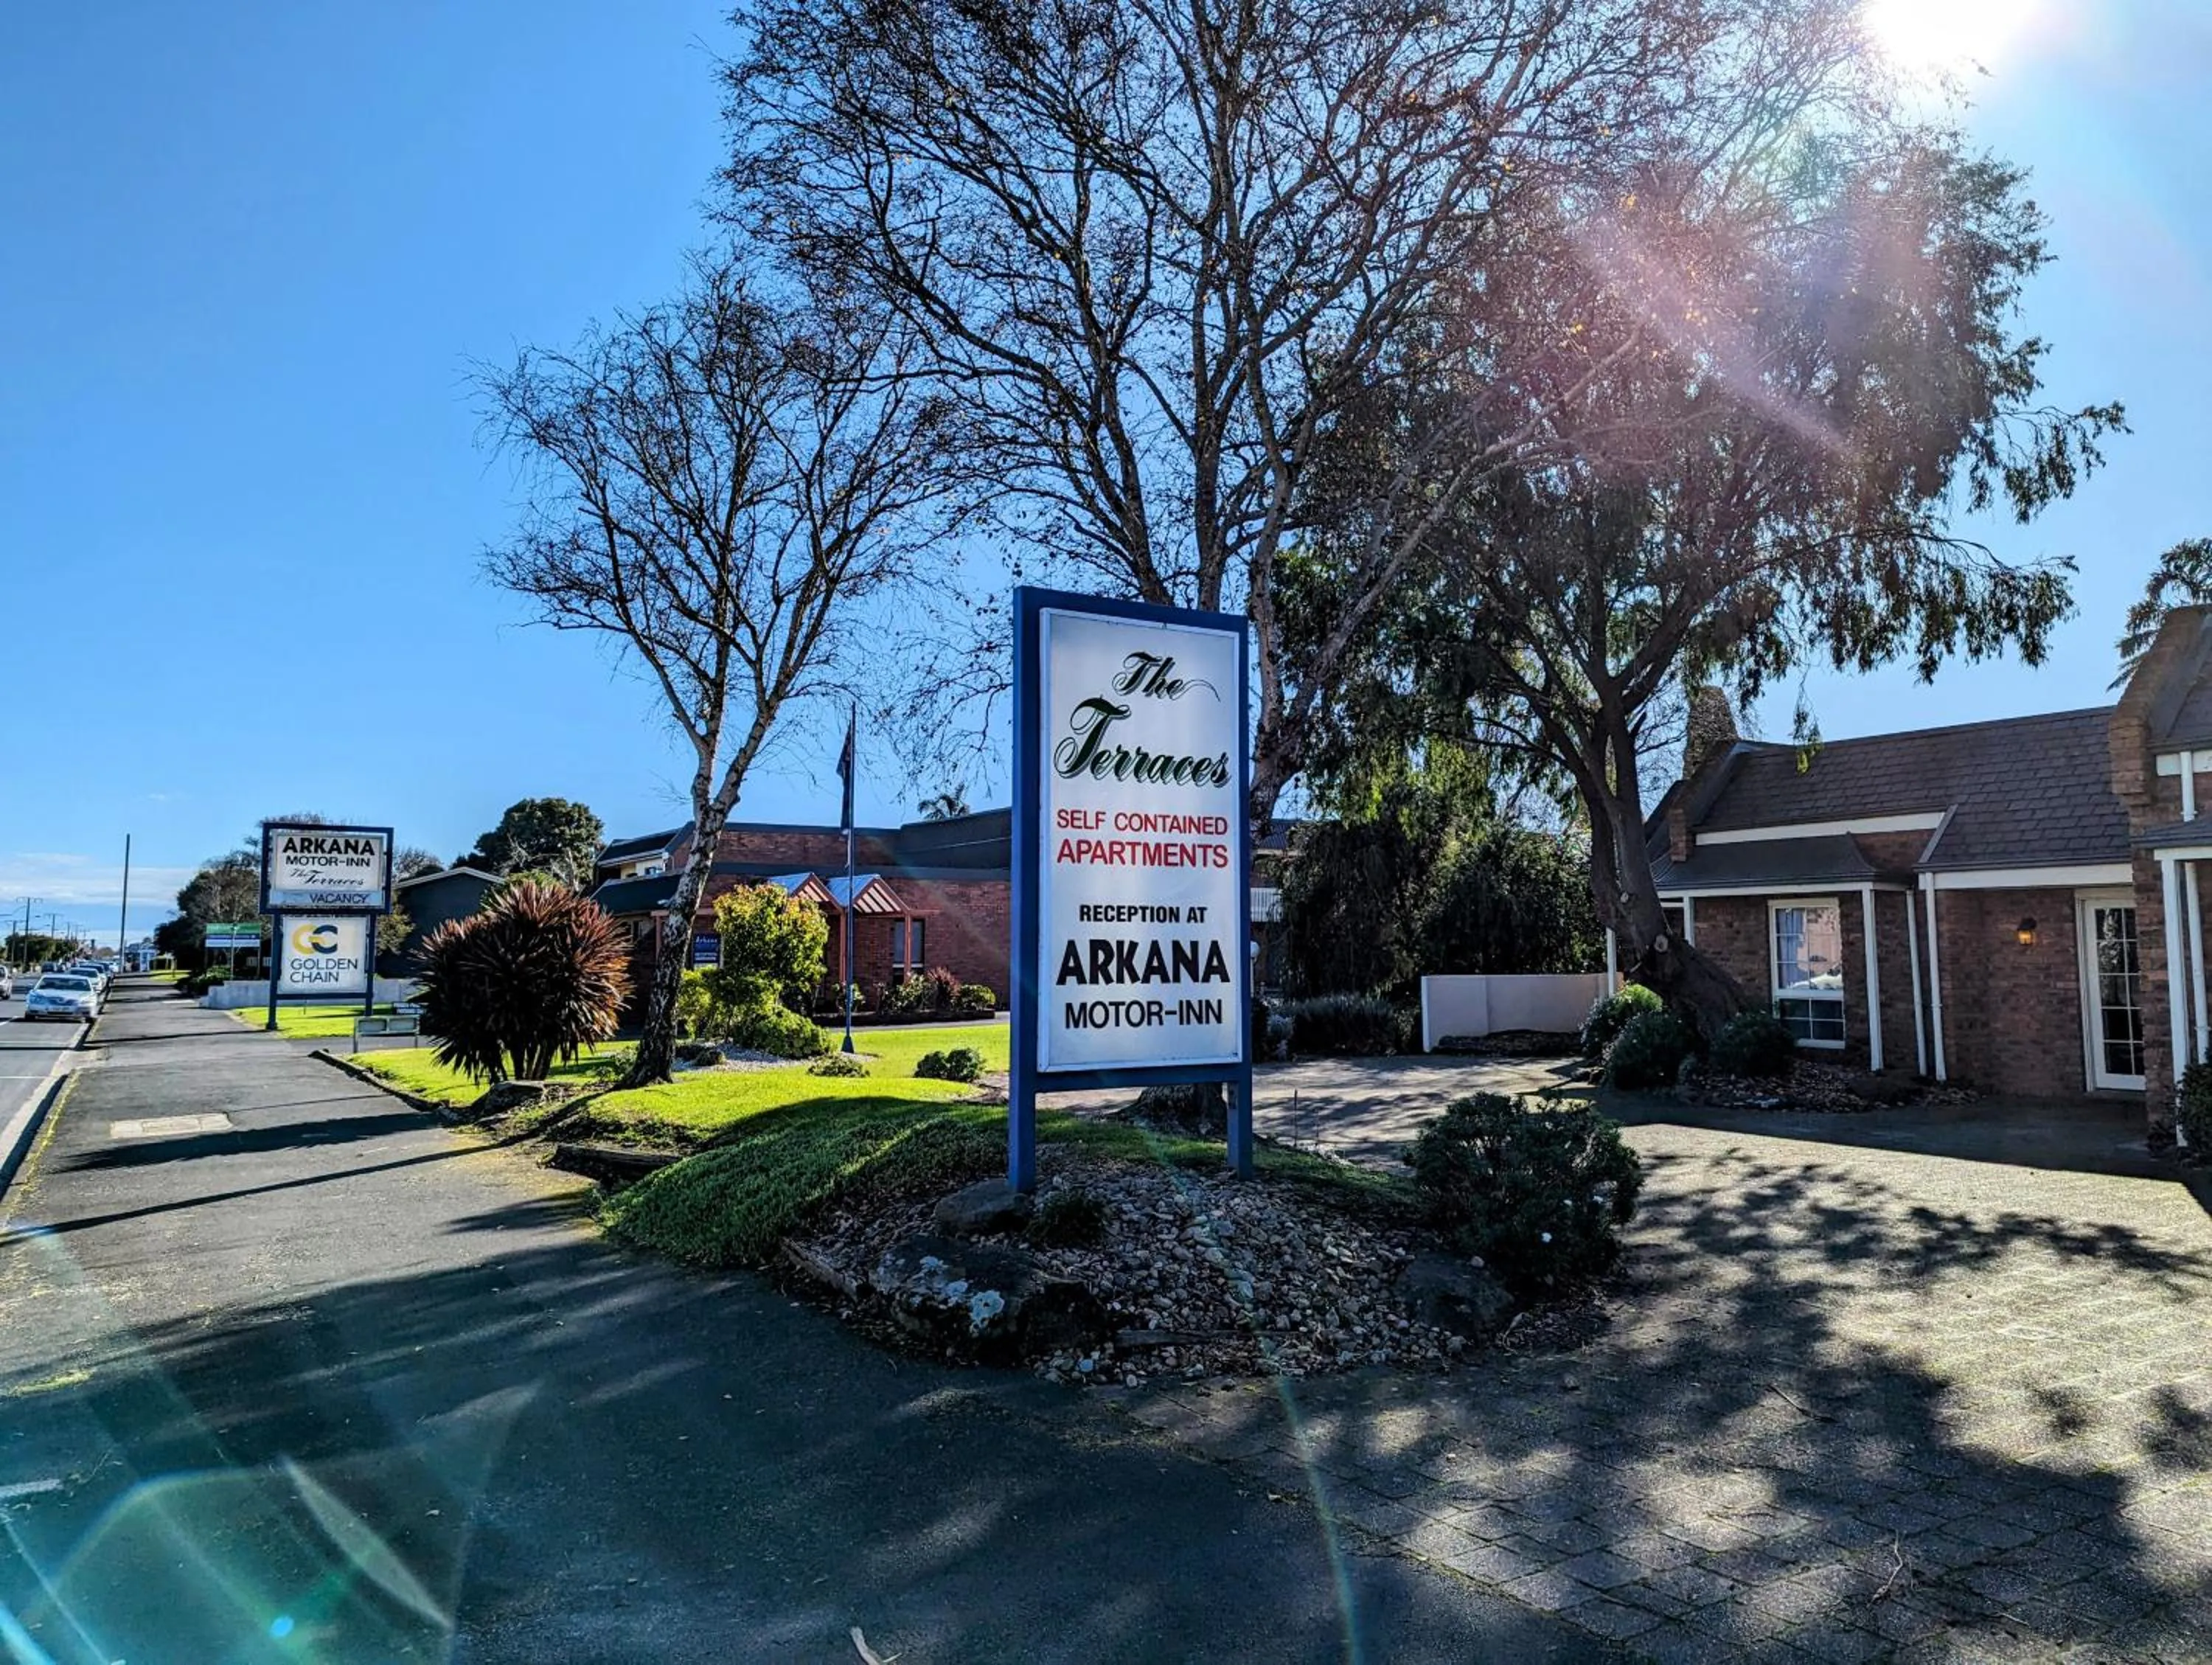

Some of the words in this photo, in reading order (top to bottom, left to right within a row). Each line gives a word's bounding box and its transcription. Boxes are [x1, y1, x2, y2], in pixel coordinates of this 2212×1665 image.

[1112, 652, 1220, 701] The
[1054, 695, 1231, 787] Terraces
[1057, 810, 1106, 831] SELF
[1115, 813, 1228, 835] CONTAINED
[283, 837, 375, 855] ARKANA
[1057, 839, 1228, 868] APARTMENTS
[285, 855, 370, 867] MOTOR-INN
[310, 893, 372, 903] VACANCY
[1079, 905, 1180, 923] RECEPTION
[1186, 906, 1207, 924] AT
[291, 959, 358, 970] GOLDEN
[1056, 940, 1230, 986] ARKANA
[290, 972, 339, 983] CHAIN
[1065, 999, 1222, 1028] MOTOR-INN
